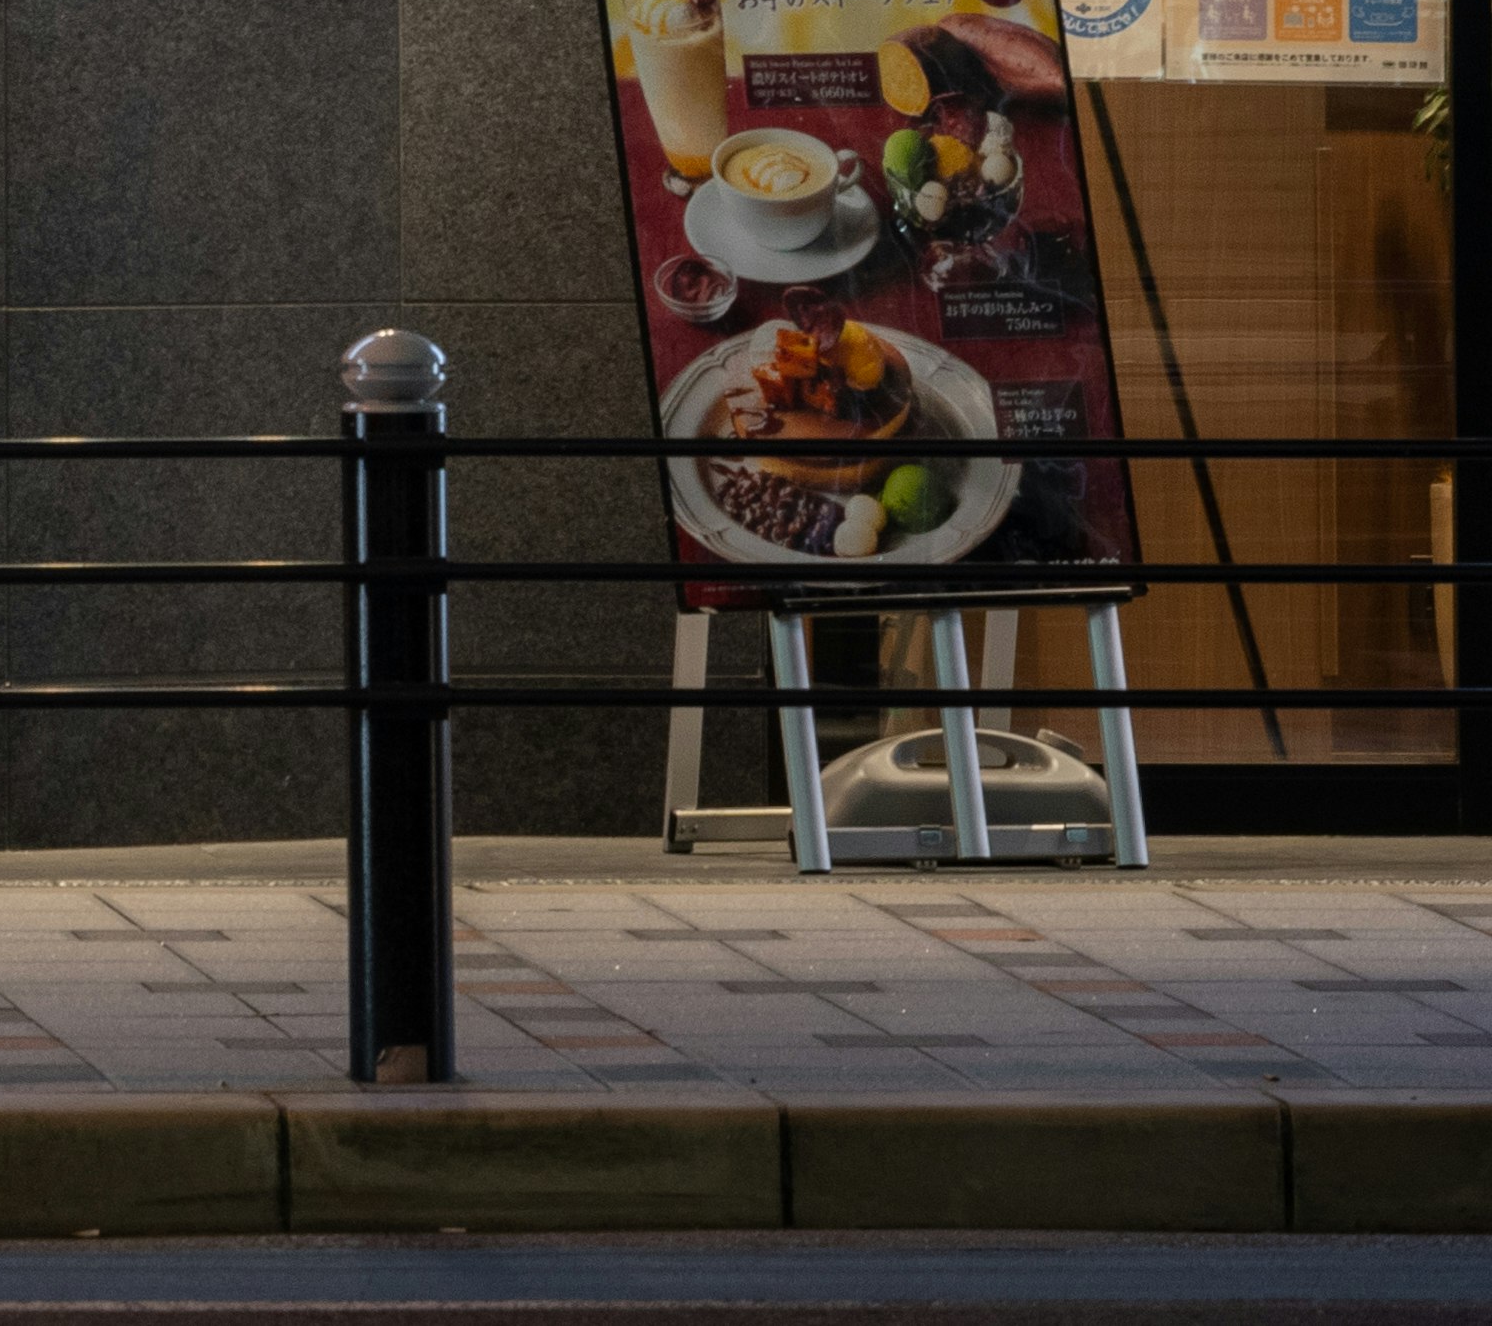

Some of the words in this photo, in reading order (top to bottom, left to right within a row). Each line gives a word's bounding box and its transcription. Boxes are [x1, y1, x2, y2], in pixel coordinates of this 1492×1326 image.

[945, 301, 1054, 318] お芋の彩りあんみつ
[1003, 424, 1066, 439] ホットケーキ
